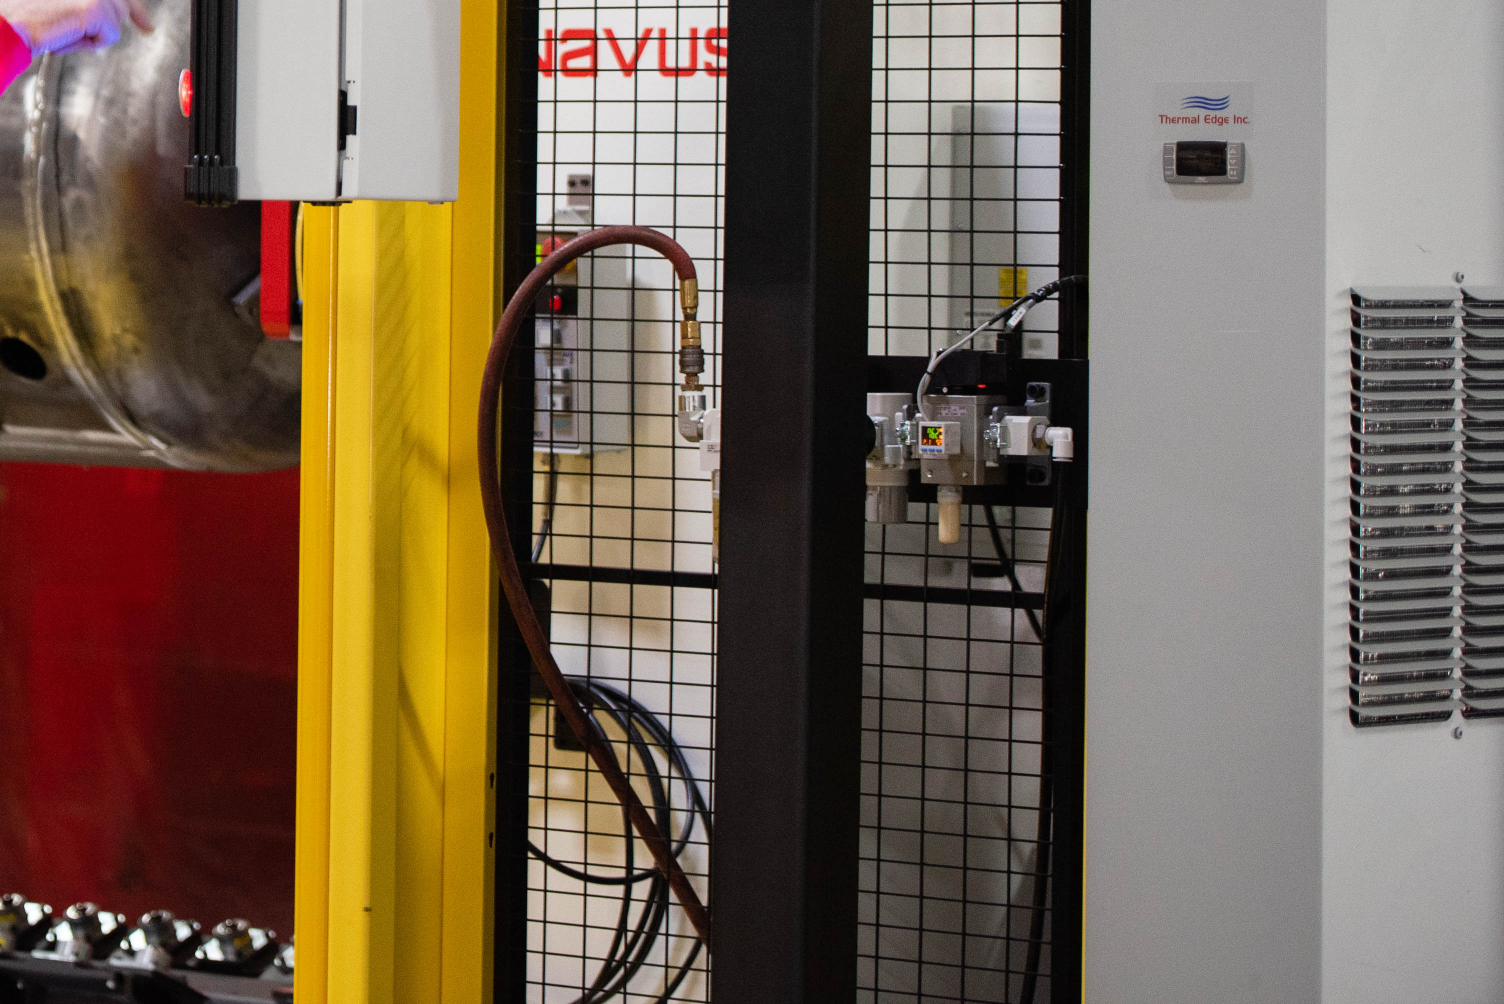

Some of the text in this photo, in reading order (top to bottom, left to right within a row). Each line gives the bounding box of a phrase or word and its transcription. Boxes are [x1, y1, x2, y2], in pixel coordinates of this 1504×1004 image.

[1158, 114, 1251, 126] Thermal Edge Inc.
